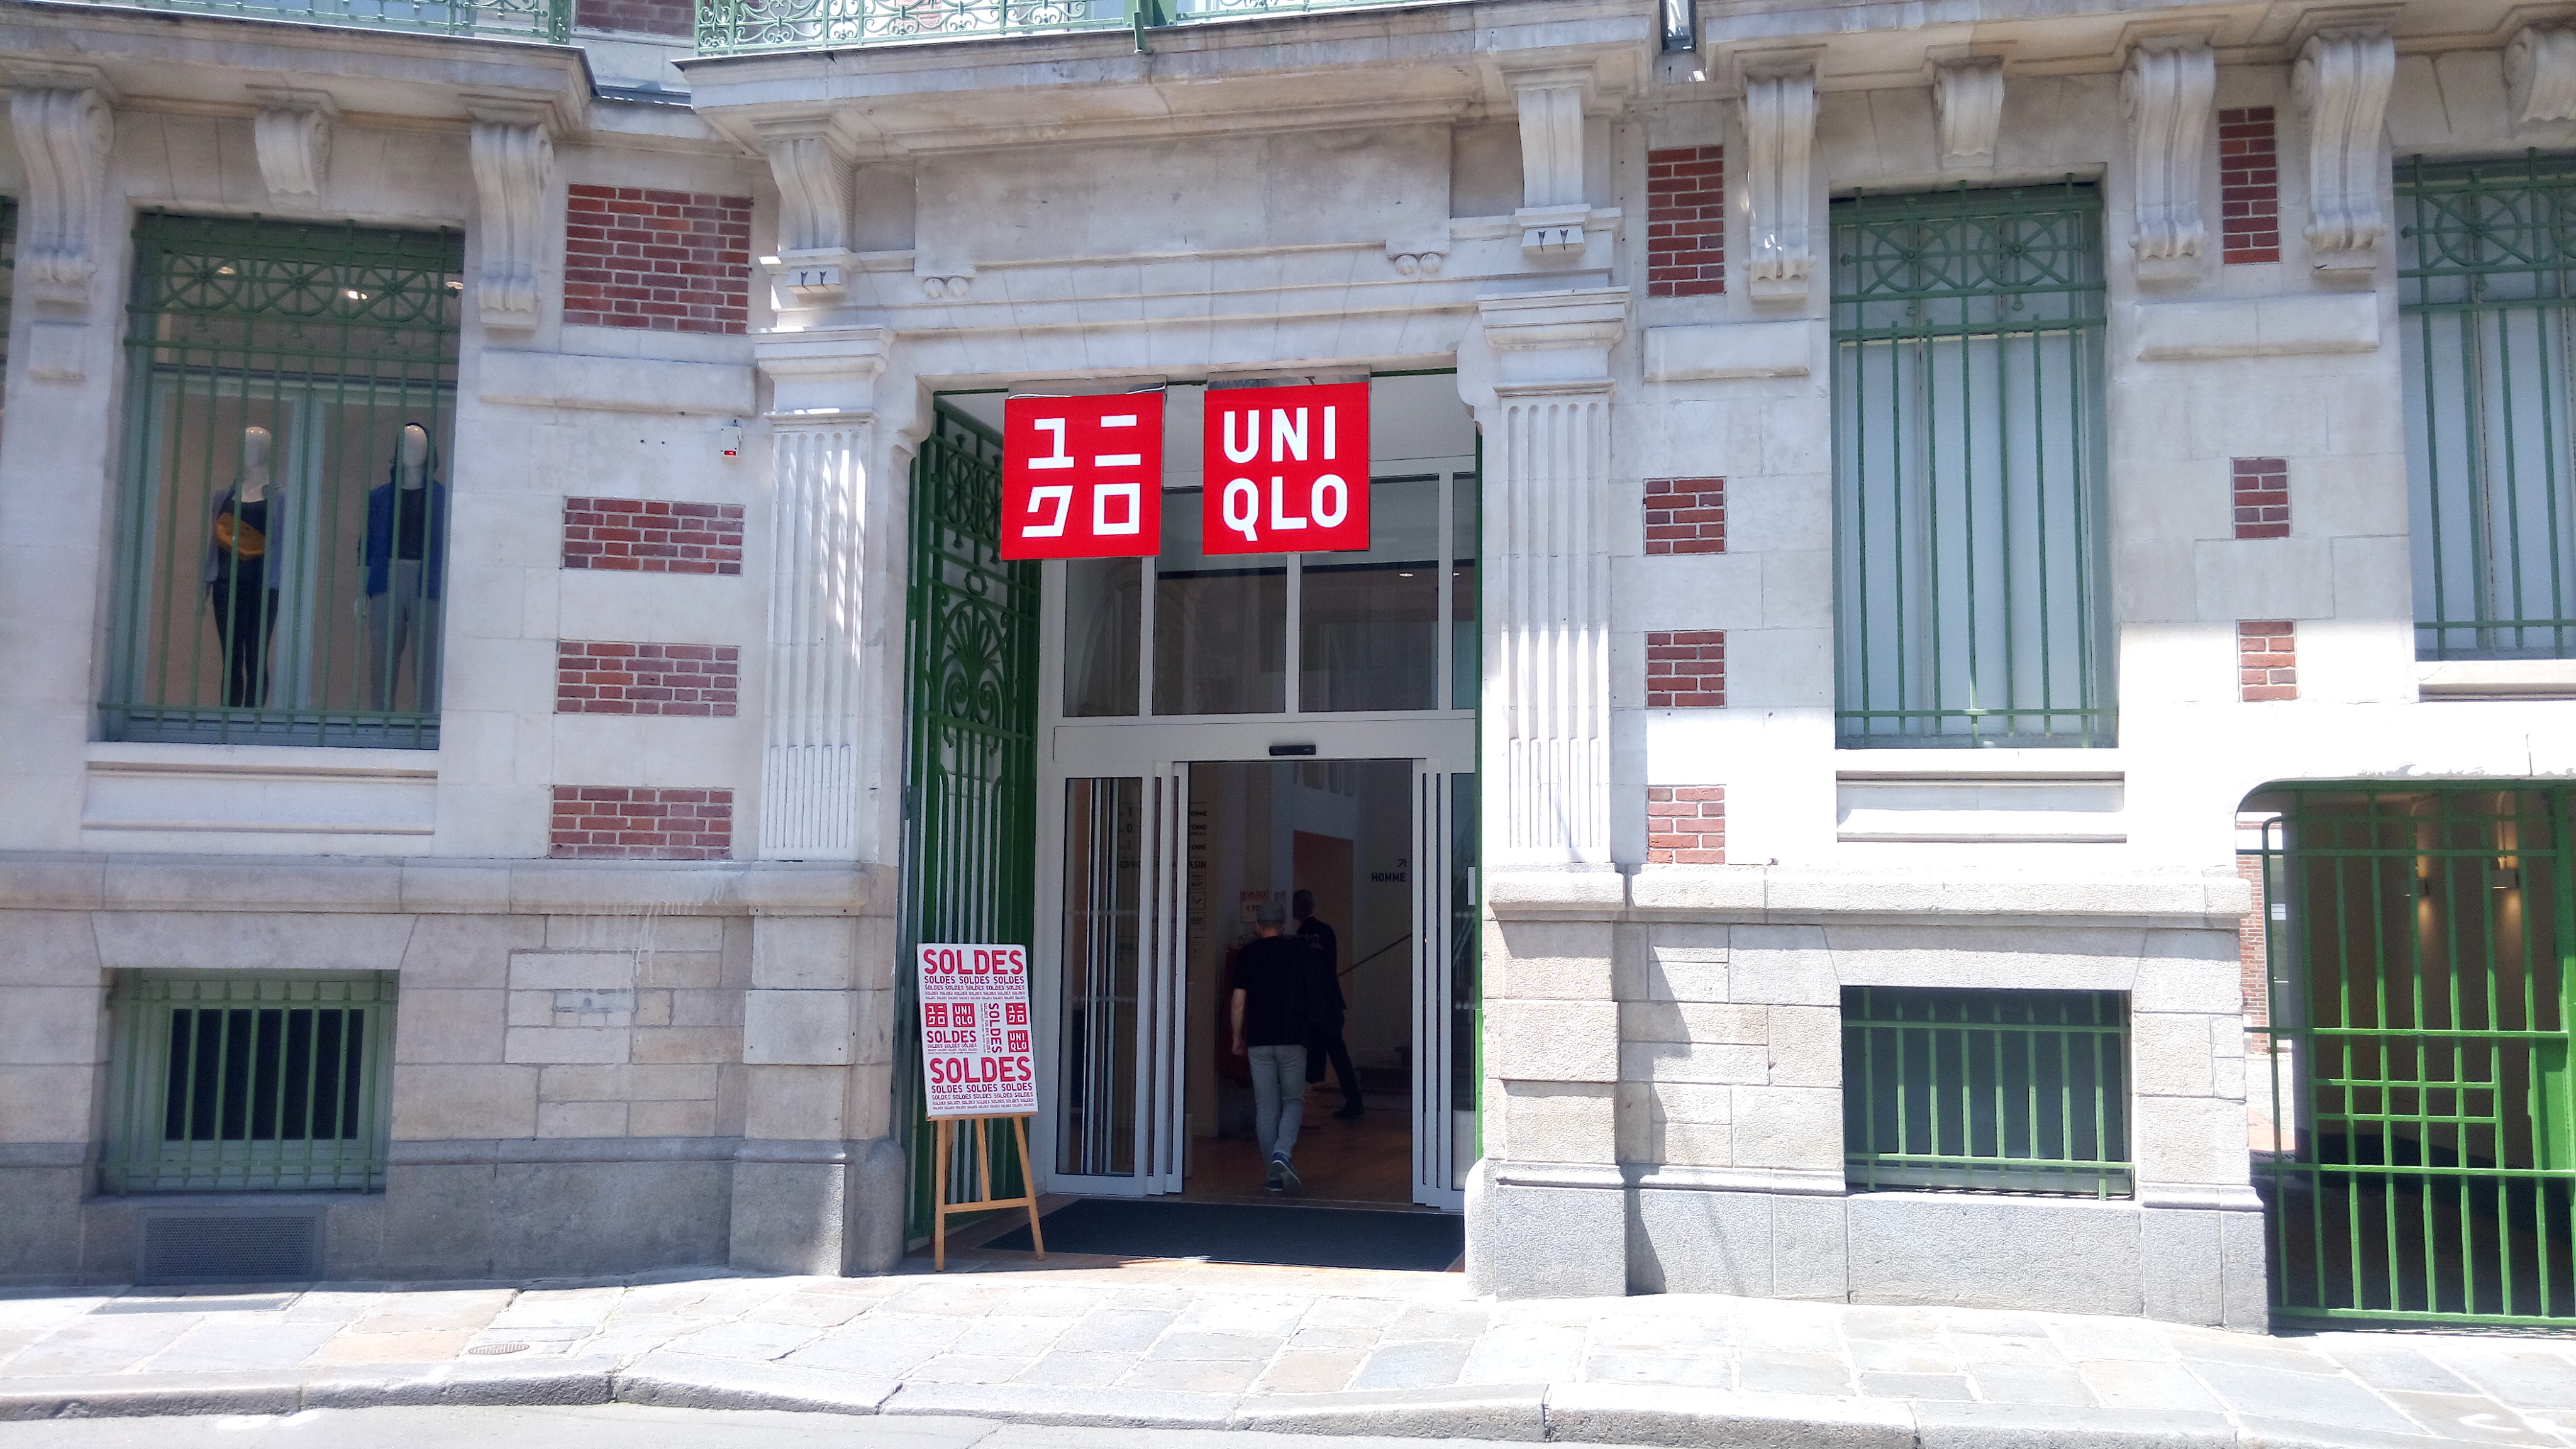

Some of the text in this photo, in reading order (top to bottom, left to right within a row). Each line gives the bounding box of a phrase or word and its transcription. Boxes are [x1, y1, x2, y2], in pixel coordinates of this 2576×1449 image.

[1223, 406, 1336, 464] UNI
[1223, 474, 1348, 541] QLO
[1372, 872, 1406, 882] HOMME
[923, 948, 1023, 975] SOLDES
[925, 975, 1024, 984] SOLDES SOLDES SOLDES
[954, 1006, 971, 1015] UNI
[955, 1016, 973, 1026] QLO
[989, 1002, 1002, 1054] SOLDES
[926, 1030, 977, 1043] SOLDES
[1009, 1033, 1024, 1041] UNI
[1011, 1041, 1027, 1051] QLO
[930, 1056, 1031, 1084] SOLDES
[932, 1083, 1032, 1093] SOLDES SOLDES SOLDES
